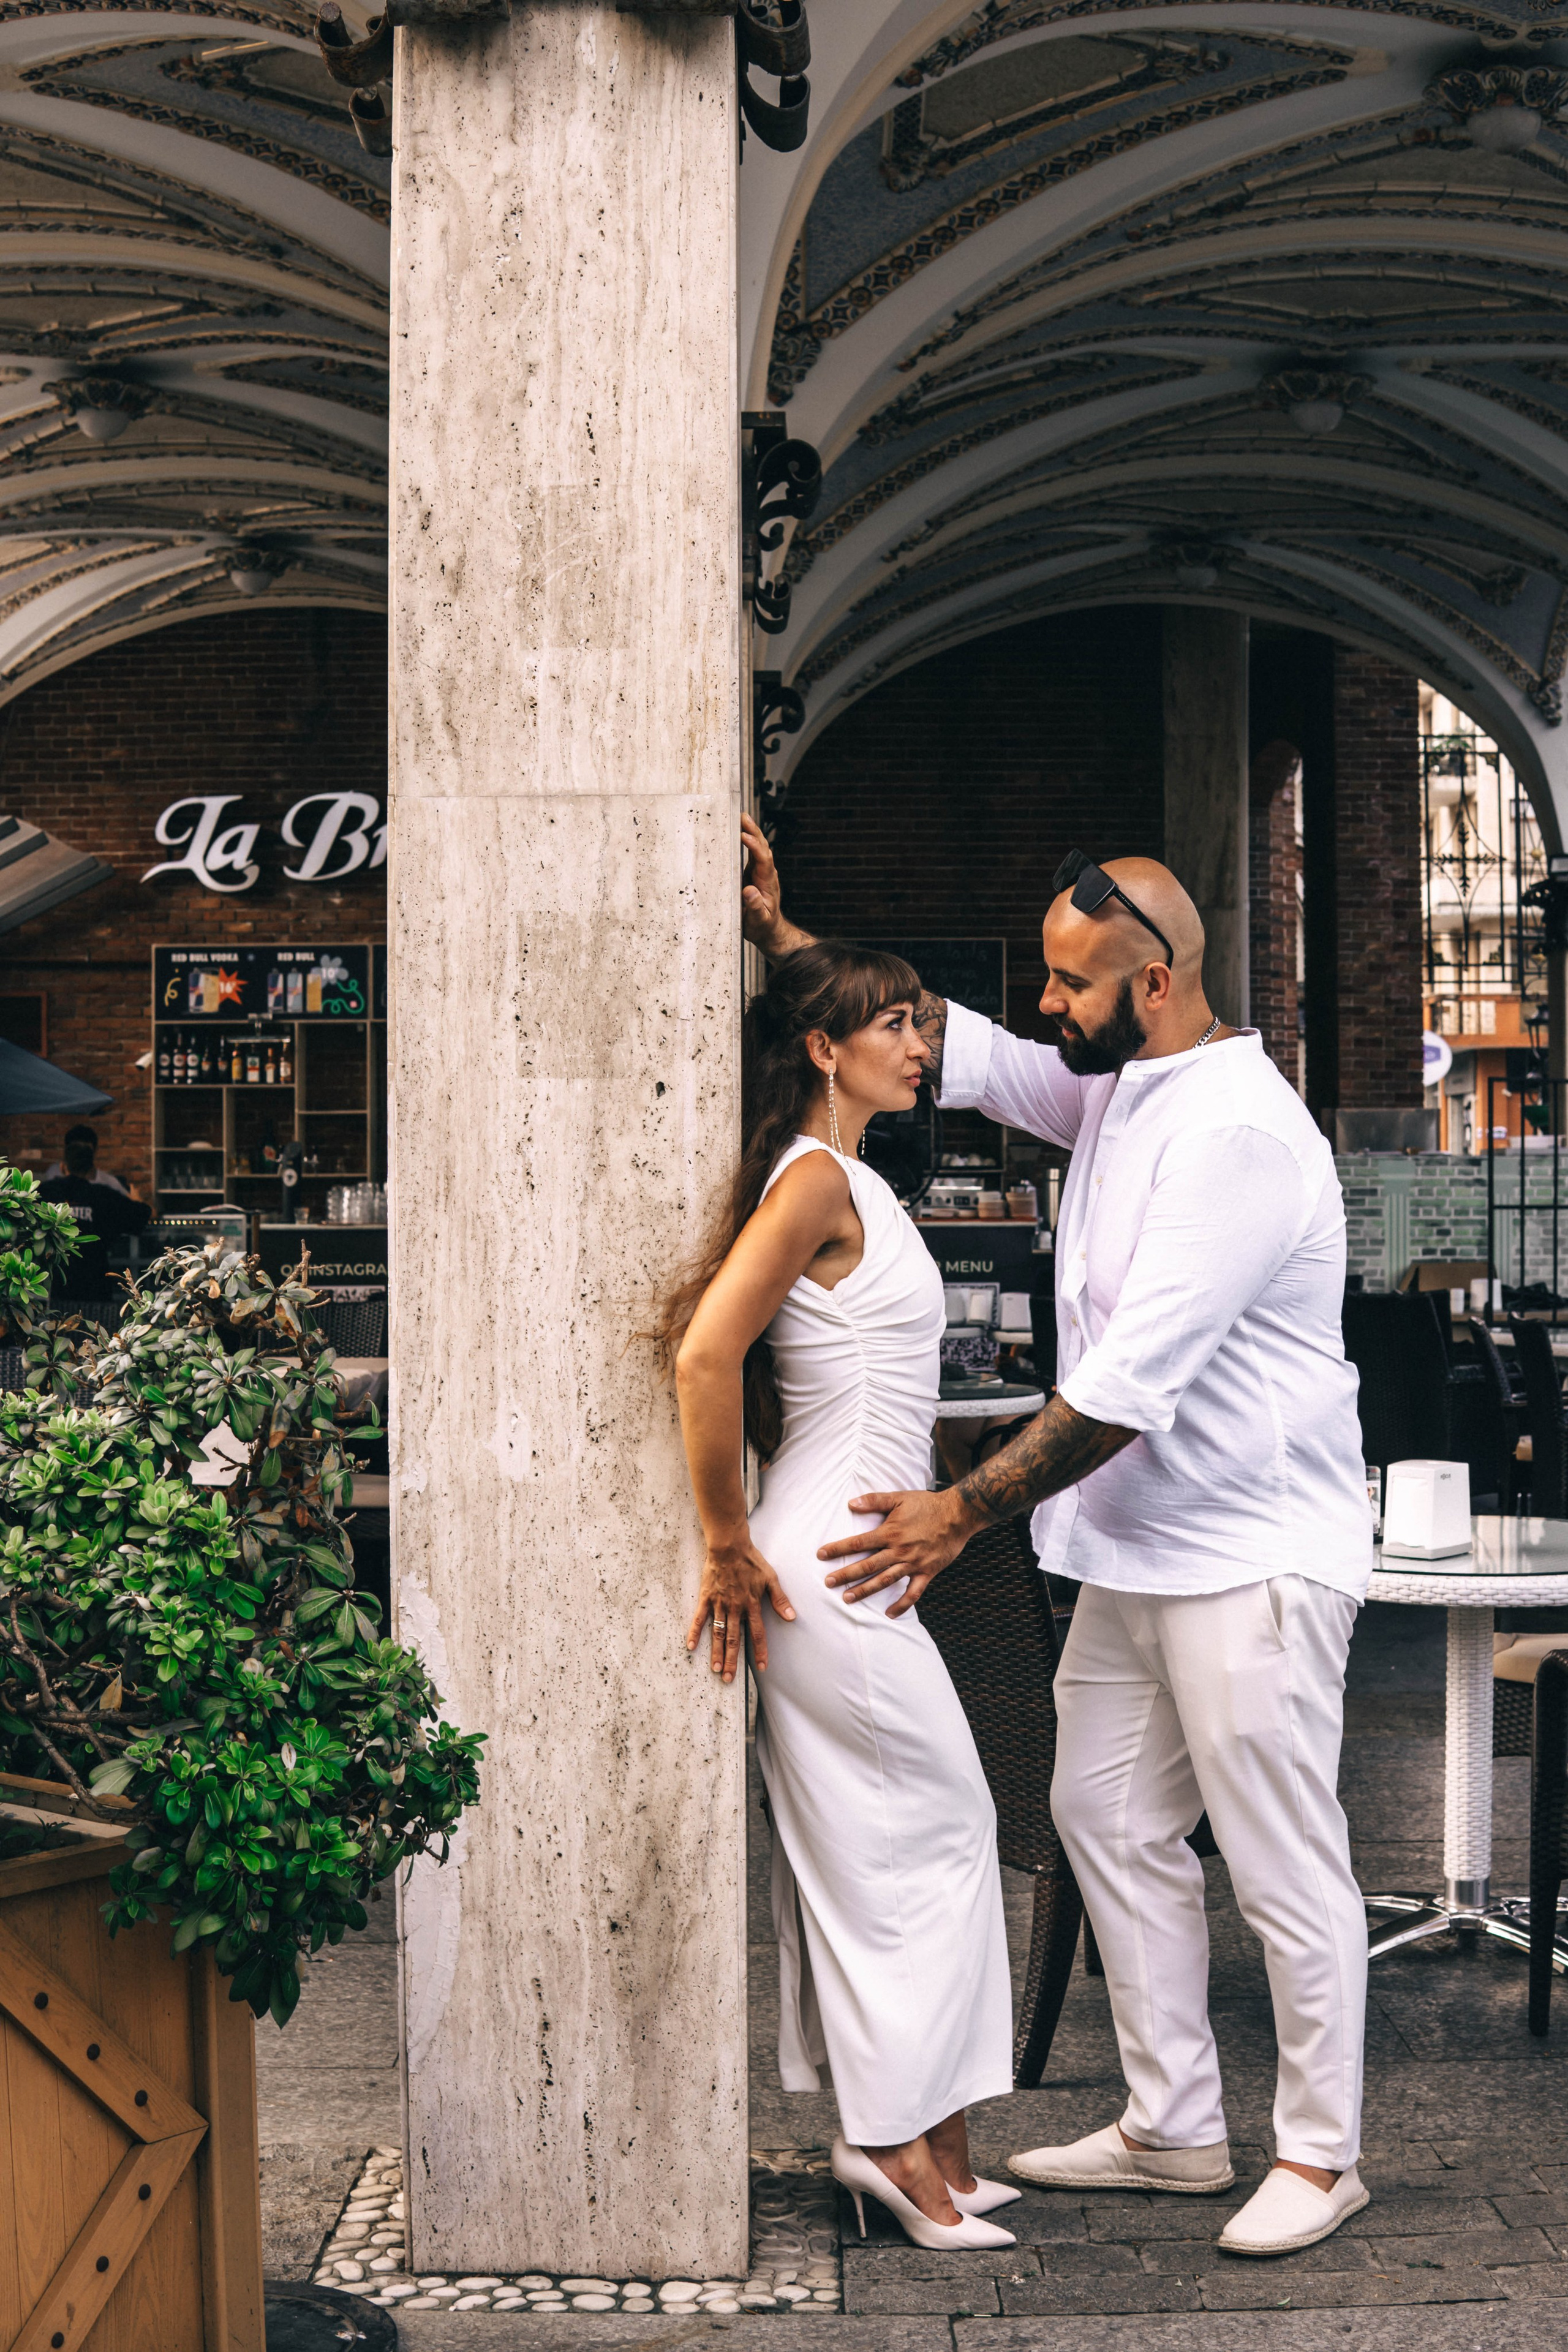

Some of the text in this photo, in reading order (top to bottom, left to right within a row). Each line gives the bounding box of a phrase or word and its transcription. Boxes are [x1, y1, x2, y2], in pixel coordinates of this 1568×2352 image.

[140, 794, 260, 892] La
[171, 952, 239, 963] RED BULL VODKA
[277, 952, 315, 962] RED BULL
[945, 1261, 993, 1273] MENU
